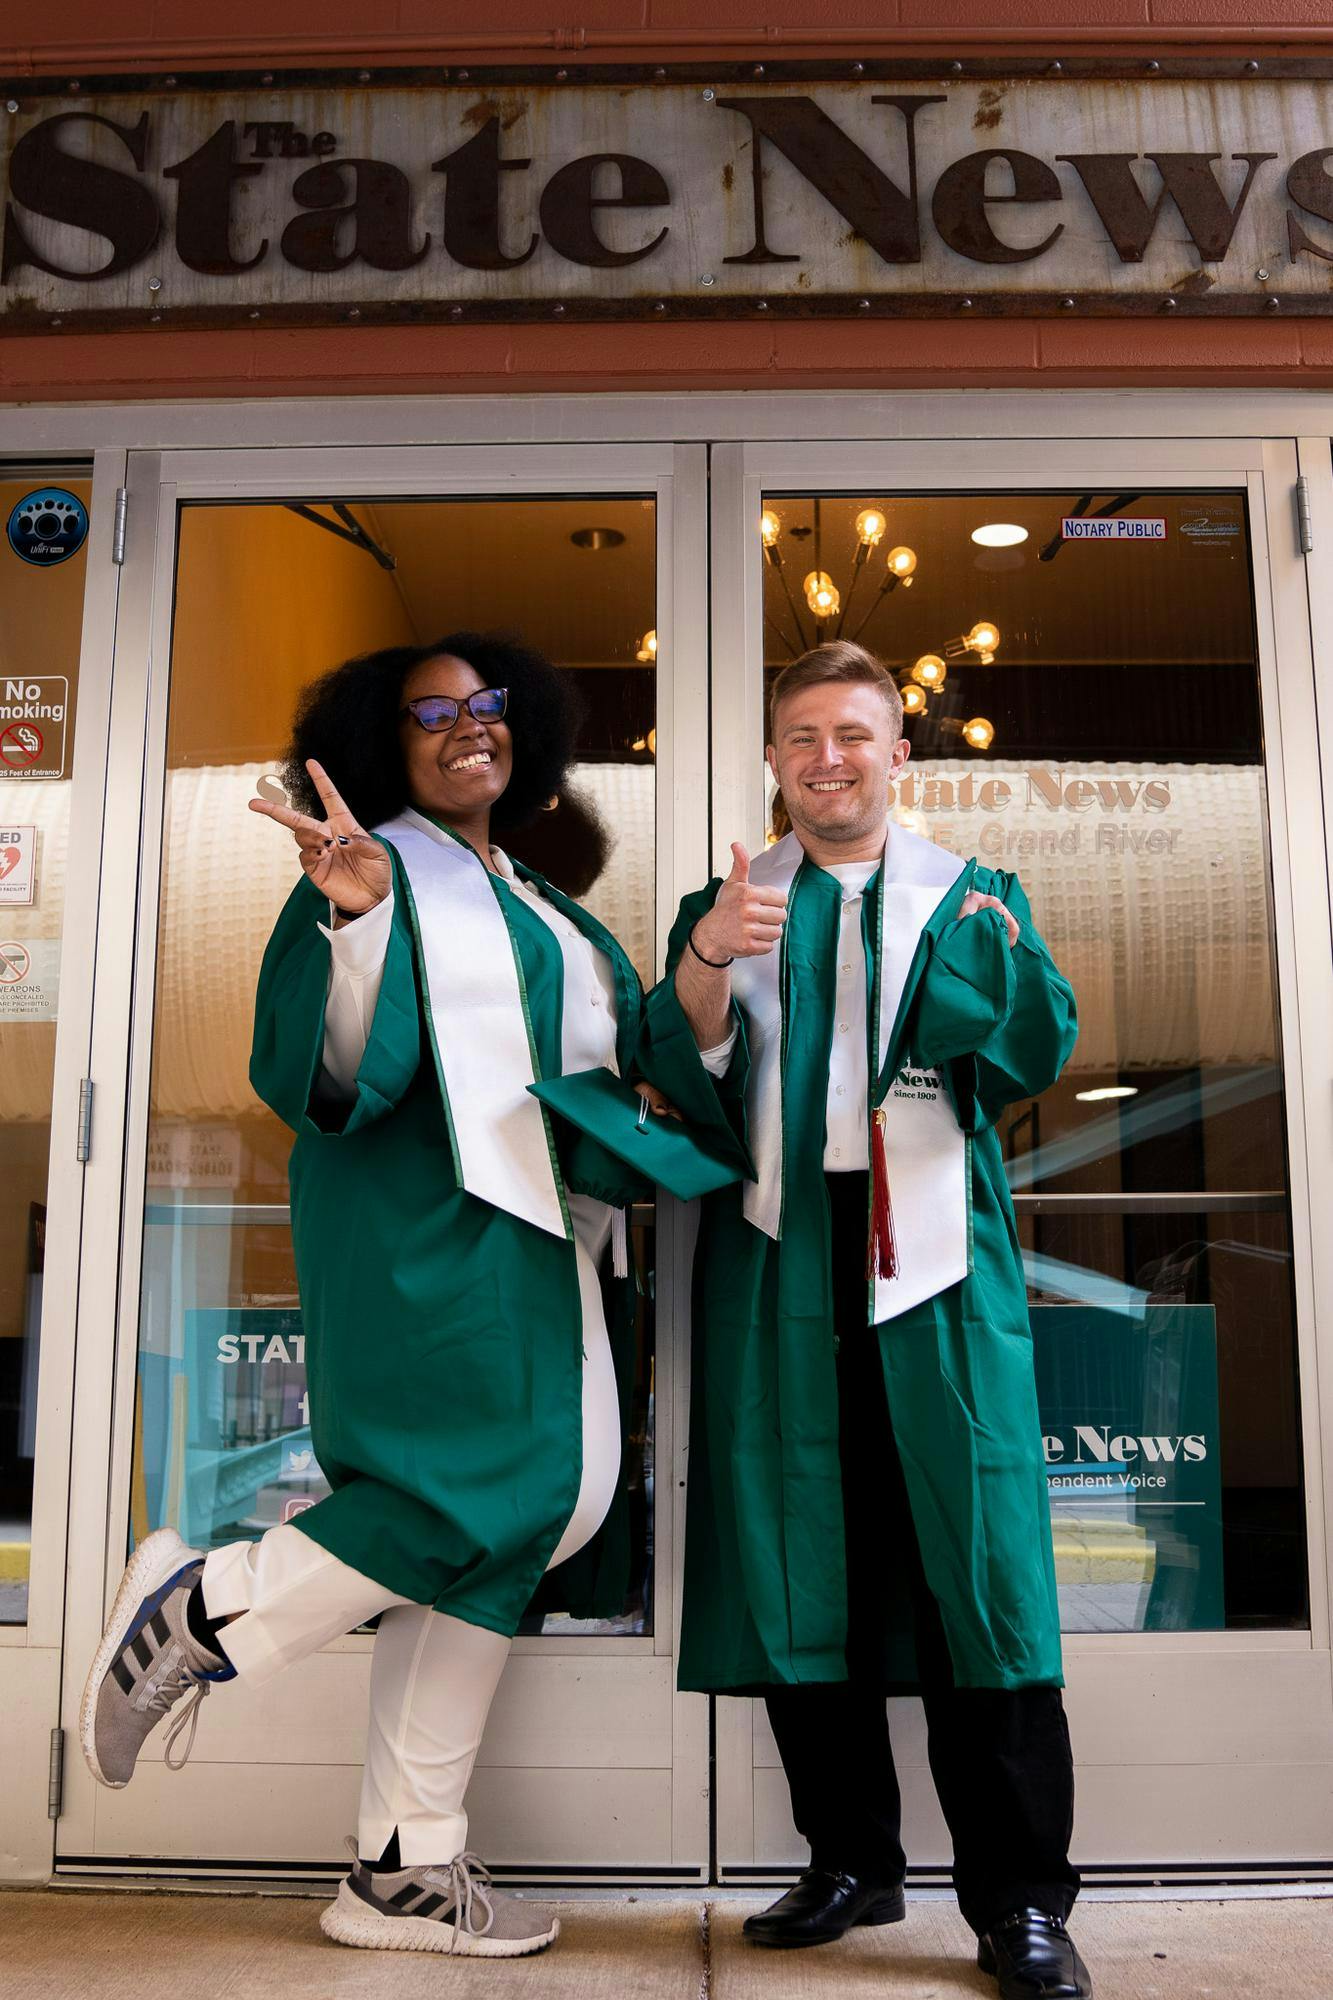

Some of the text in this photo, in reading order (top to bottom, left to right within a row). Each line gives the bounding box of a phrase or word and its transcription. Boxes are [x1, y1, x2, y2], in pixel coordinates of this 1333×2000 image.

[243, 121, 336, 158] The
[2, 112, 670, 285] State
[1065, 521, 1113, 537] NOTARY
[1117, 520, 1163, 538] PUBLIC
[6, 680, 41, 701] No
[917, 769, 936, 779] The
[1025, 769, 1171, 807] News
[979, 822, 1081, 854] Grand
[1095, 822, 1184, 854] River
[894, 1090, 937, 1101] Since 1909
[1073, 1425, 1207, 1463] News
[1119, 1474, 1167, 1488] Voice
